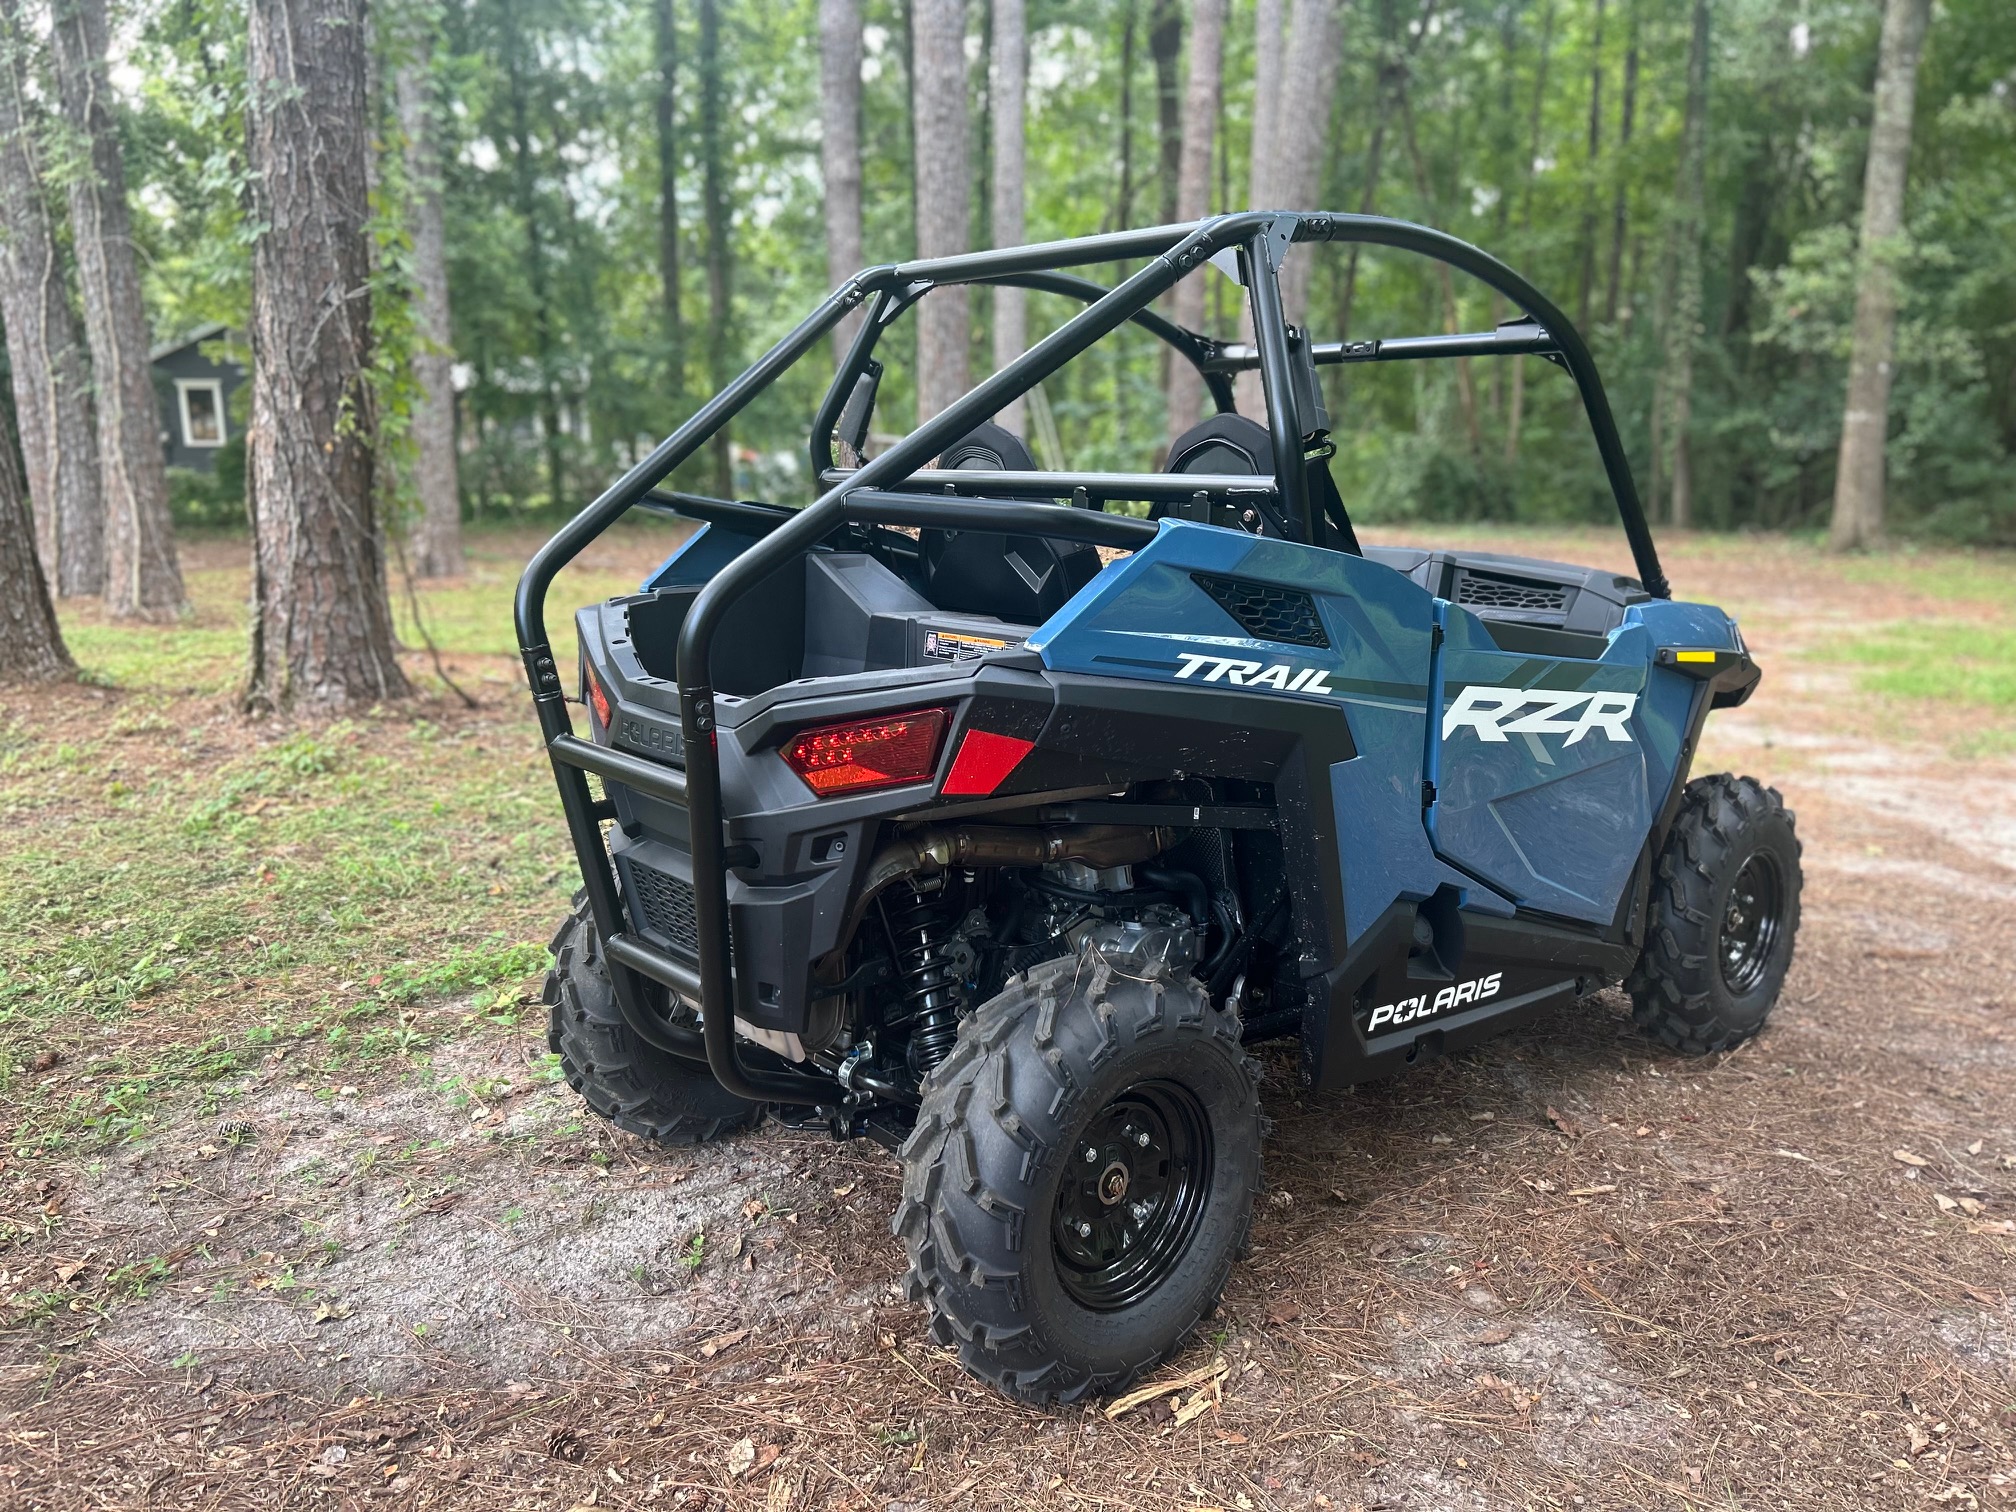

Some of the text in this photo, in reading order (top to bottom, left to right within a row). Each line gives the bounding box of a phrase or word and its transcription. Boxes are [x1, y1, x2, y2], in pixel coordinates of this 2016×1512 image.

[1174, 652, 1333, 694] TRAIL
[1442, 685, 1637, 748] RZR
[1367, 971, 1503, 1032] POLARIS
